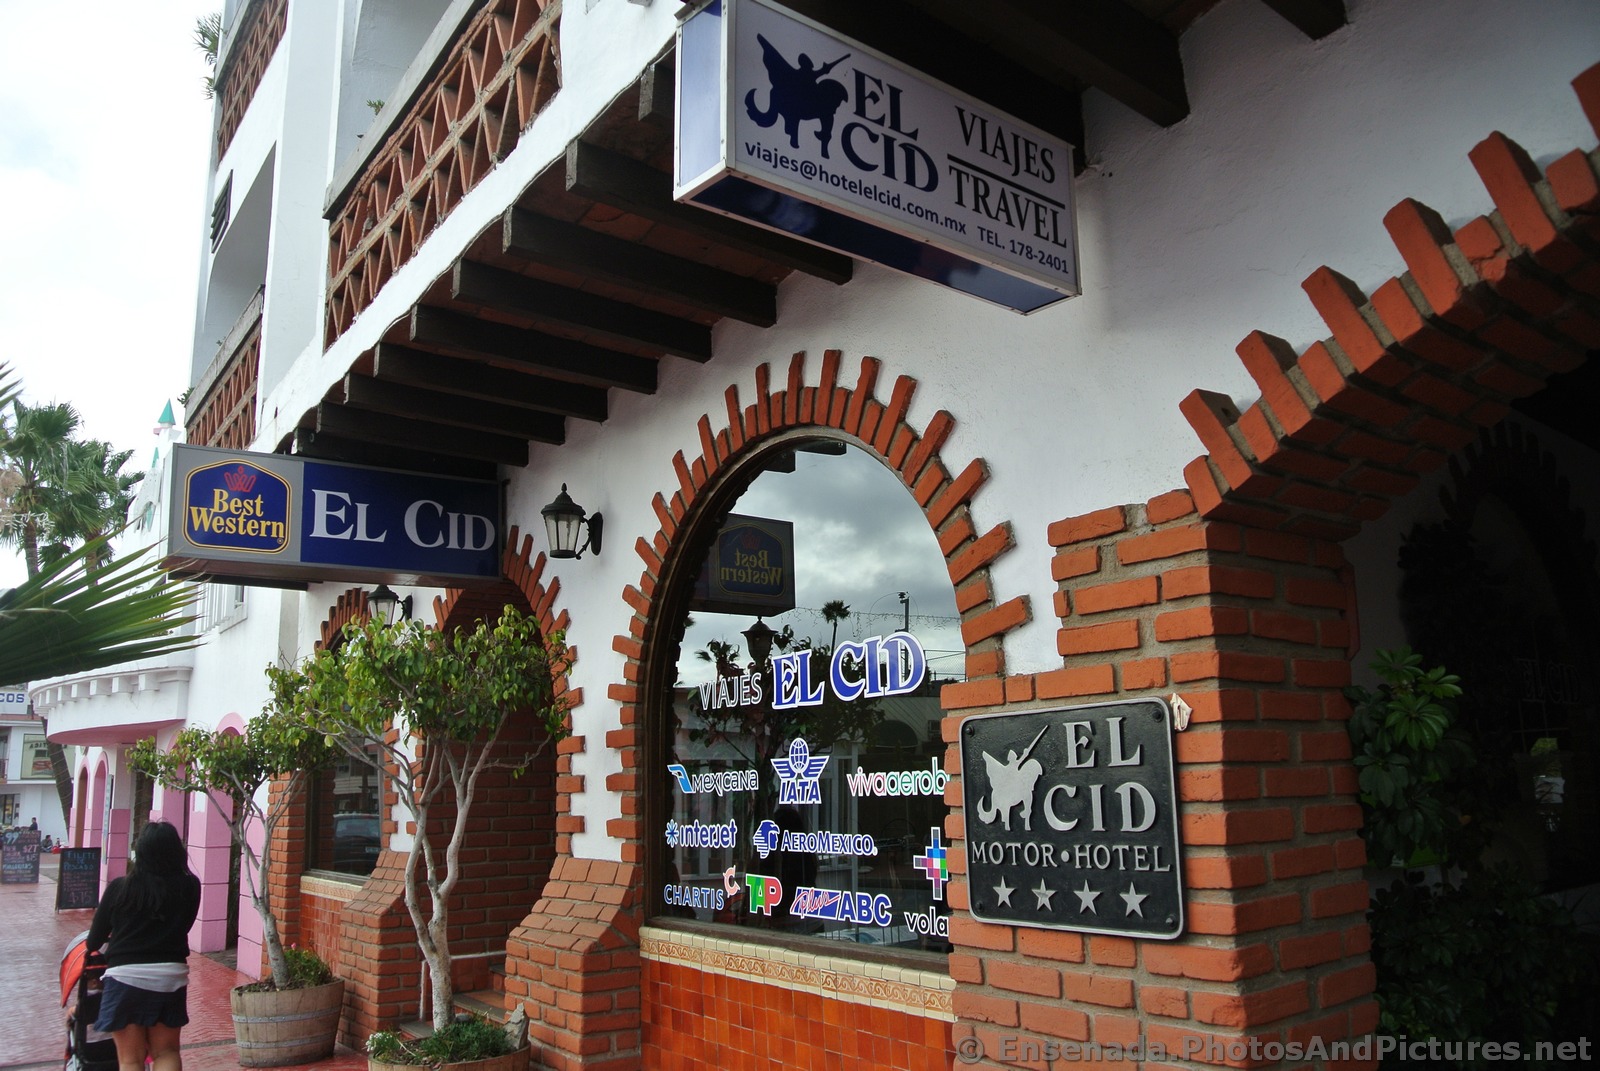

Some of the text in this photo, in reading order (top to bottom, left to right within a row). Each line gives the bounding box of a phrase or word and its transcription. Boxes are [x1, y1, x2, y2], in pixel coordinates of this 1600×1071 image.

[852, 68, 919, 140] EL
[841, 122, 939, 193] CID
[954, 105, 1056, 184] VIAJES
[744, 141, 1069, 274] viajes@hotelelcid.com.mx TEL. 178-2401
[949, 165, 1068, 249] TRAVEL
[189, 506, 285, 539] Western
[213, 488, 264, 517] Best
[699, 631, 926, 711] VIAJES EL CID
[1063, 716, 1144, 769] EL
[779, 778, 822, 804] IATA
[846, 756, 948, 797] vivaaerob
[1043, 781, 1157, 833] CID
[663, 883, 725, 911] CHARTIS
[745, 873, 783, 916] TAP
[838, 890, 893, 927] ABC
[904, 906, 948, 937] vola
